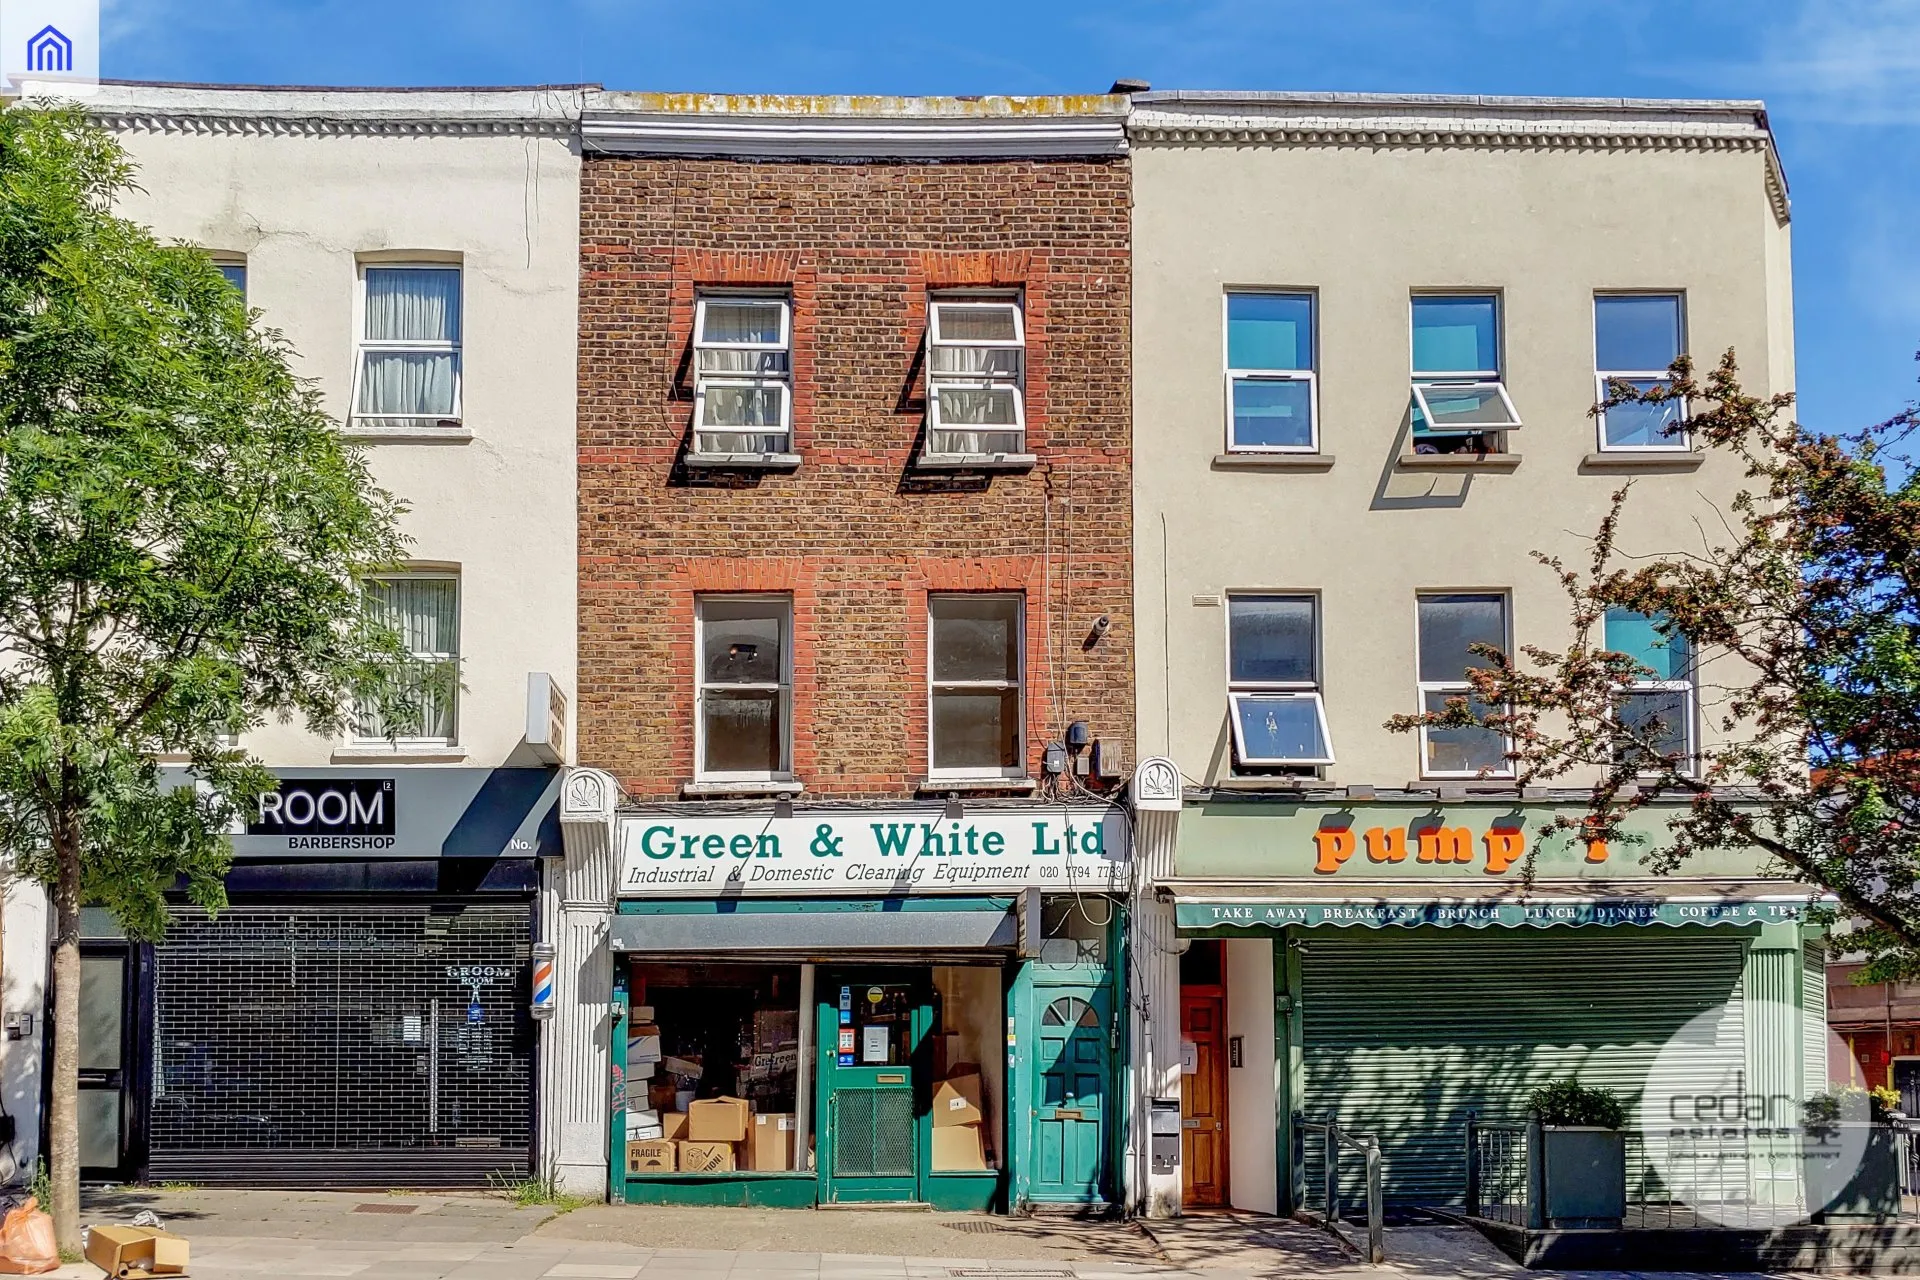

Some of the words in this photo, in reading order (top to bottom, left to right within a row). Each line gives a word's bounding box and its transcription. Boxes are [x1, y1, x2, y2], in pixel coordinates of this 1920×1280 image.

[288, 837, 395, 849] BARBERSHOP
[510, 839, 532, 850] No.
[641, 825, 783, 860] Green
[809, 823, 844, 858] &
[870, 822, 1005, 857] White
[1031, 822, 1107, 855] Ltd
[627, 865, 715, 883] Industrial
[727, 865, 743, 882] &
[749, 864, 834, 881] Domestic
[845, 863, 925, 883] Cleaning
[933, 863, 1030, 883] Equipment
[1039, 865, 1059, 878] 020
[1211, 907, 1254, 918] TAKE
[1265, 907, 1308, 919] AWAY
[1323, 908, 1418, 919] BREAKFAST
[1437, 907, 1500, 919] BRUNCH
[1524, 907, 1576, 919] LUNCH
[1597, 906, 1659, 919] DINNER
[1679, 905, 1740, 917] COFFEE
[1747, 905, 1758, 916] &
[1768, 904, 1798, 917] TEA
[631, 1148, 662, 1158] FRAGILE
